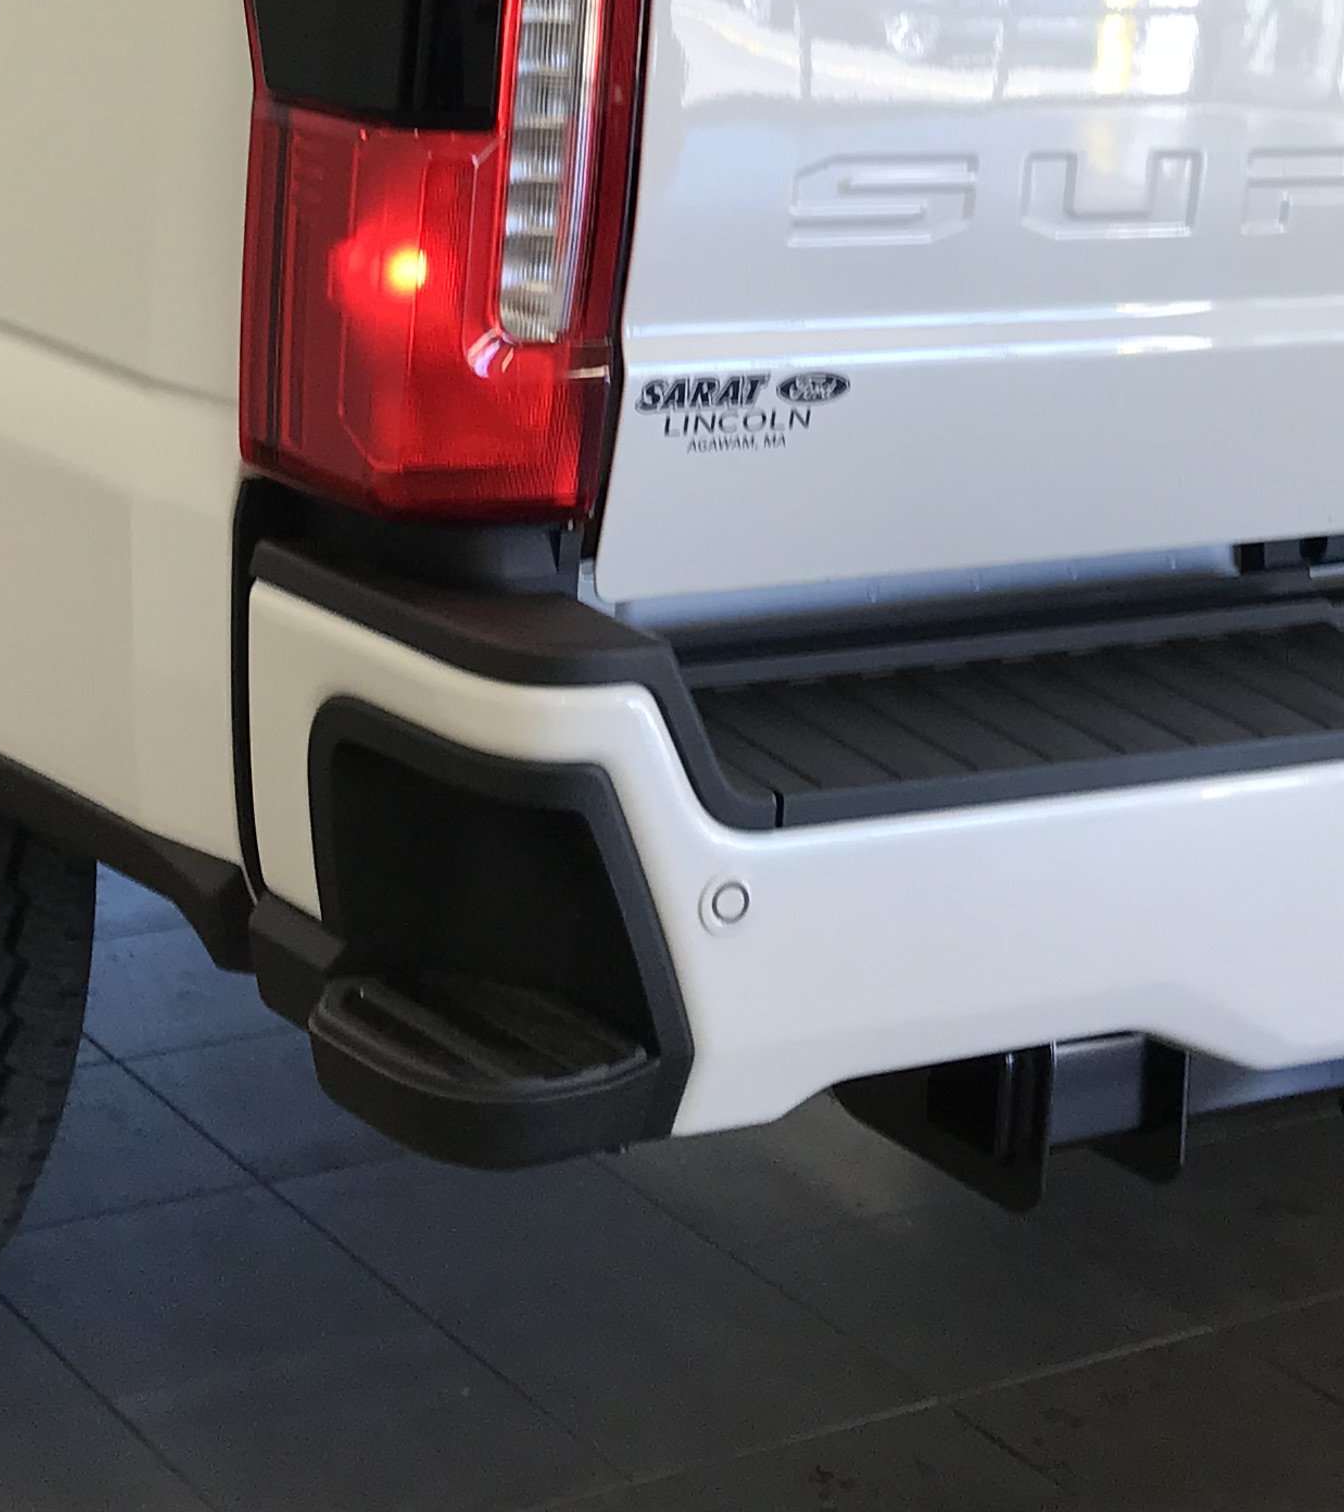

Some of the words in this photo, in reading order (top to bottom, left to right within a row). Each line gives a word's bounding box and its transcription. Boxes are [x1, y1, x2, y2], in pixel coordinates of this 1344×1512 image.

[636, 373, 770, 414] SARAT
[664, 408, 811, 436] LINCOLN
[763, 432, 787, 449] MA
